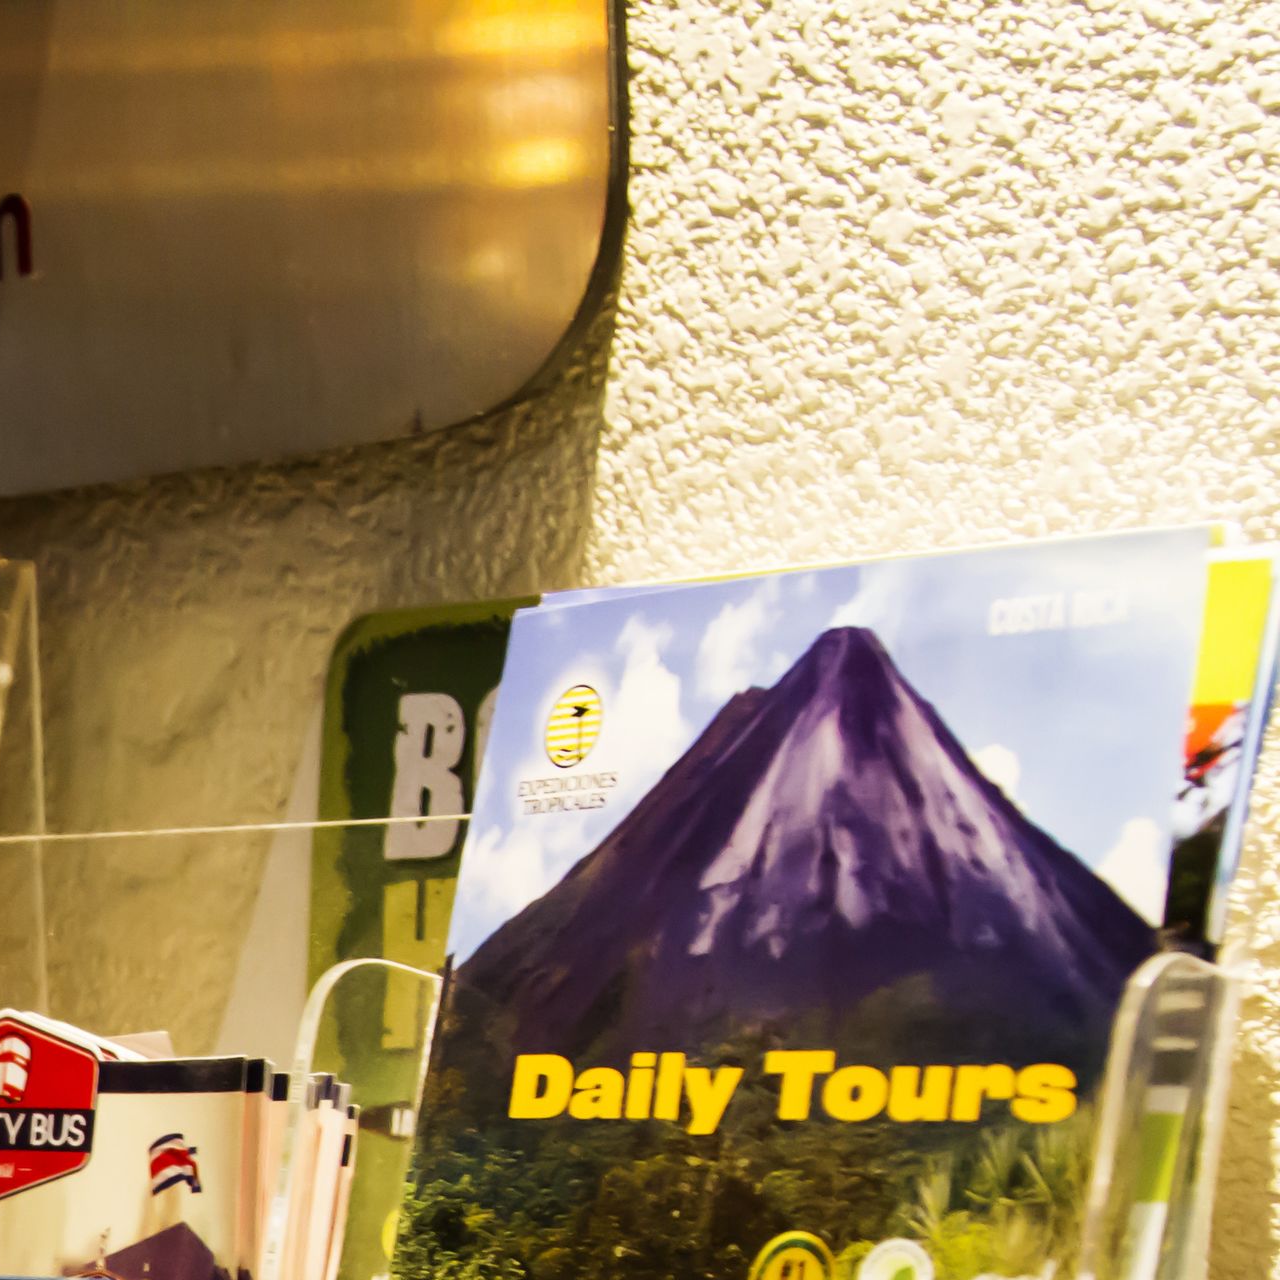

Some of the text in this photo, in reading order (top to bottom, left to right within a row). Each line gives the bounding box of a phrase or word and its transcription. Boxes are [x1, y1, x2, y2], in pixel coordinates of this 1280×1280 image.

[508, 1050, 1077, 1136] Daily Tours
[30, 1113, 87, 1147] BUS
